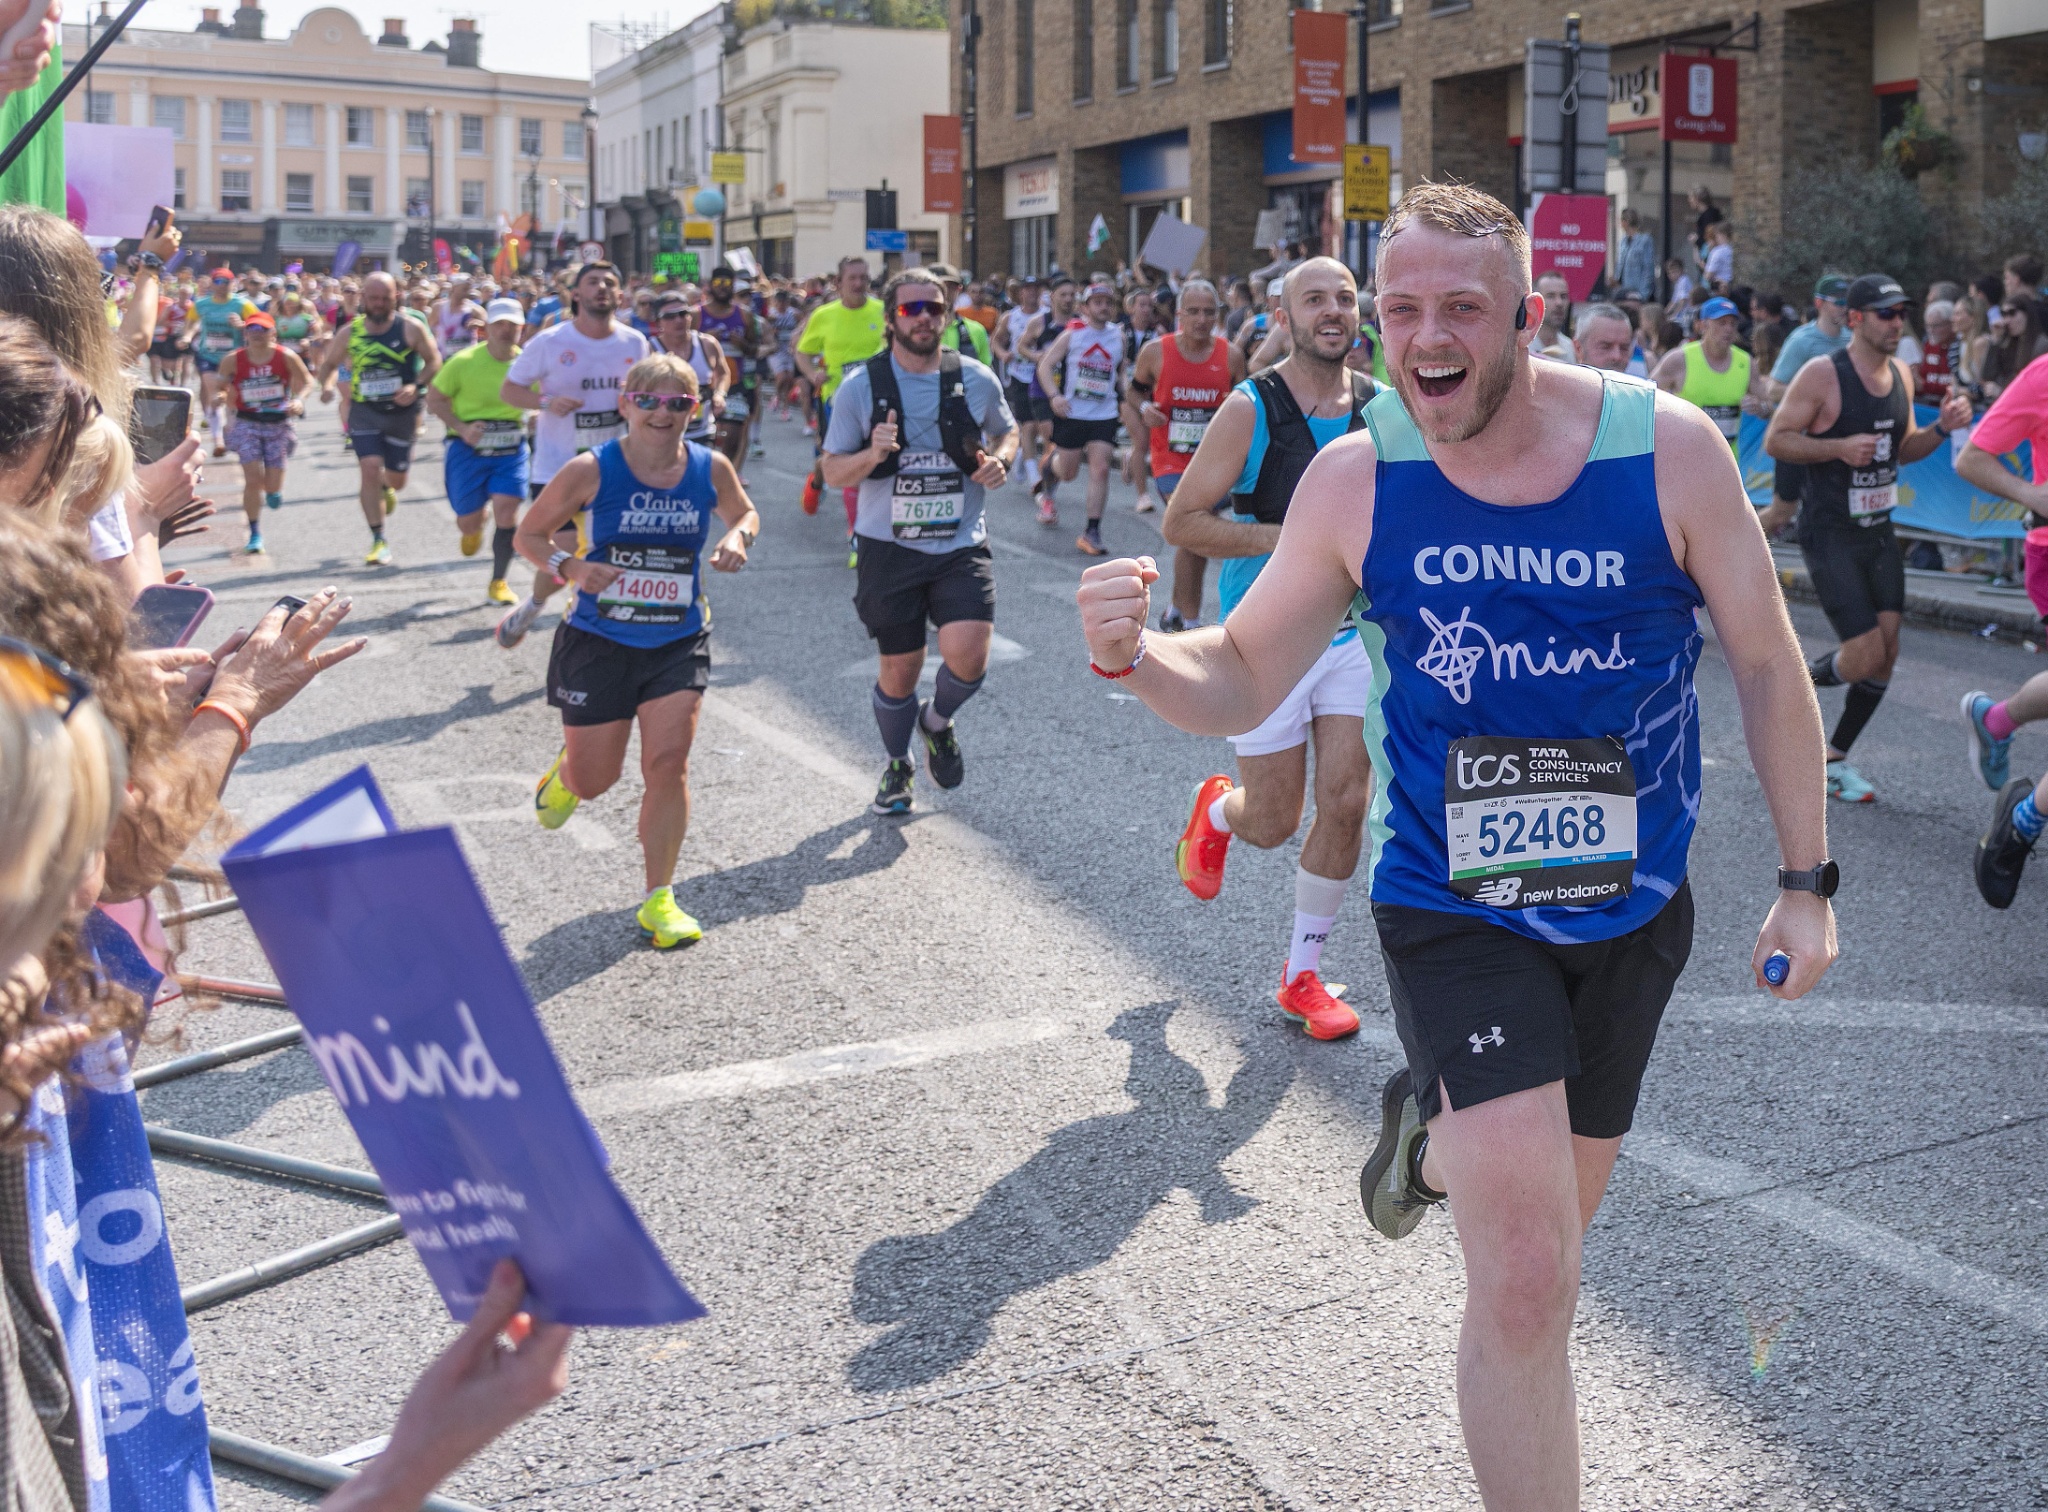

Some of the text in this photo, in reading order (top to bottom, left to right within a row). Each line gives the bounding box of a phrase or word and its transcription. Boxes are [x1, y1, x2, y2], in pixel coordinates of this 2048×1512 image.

[1560, 223, 1581, 236] NO
[1533, 237, 1607, 253] SPECTATORS
[1553, 255, 1584, 268] HERE
[582, 377, 621, 390] OLLIE
[1171, 386, 1220, 402] SUNNY
[895, 475, 923, 494] tcs
[629, 491, 695, 512] Claire
[903, 500, 955, 519] 76728
[620, 510, 700, 527] TOTTON
[617, 525, 700, 534] RUNNING CLUB
[610, 546, 643, 568] tcs
[1413, 544, 1626, 588] CONNOR
[616, 577, 680, 601] 14009
[1457, 747, 1570, 790] tcs TATA
[1528, 758, 1623, 774] CONSULTANCY
[1528, 771, 1590, 784] SERVICES
[1478, 804, 1606, 858] 52468
[1582, 854, 1607, 862] RELAXED
[1485, 864, 1505, 873] MEDAL
[1523, 889, 1555, 904] new
[1557, 882, 1619, 901] balance
